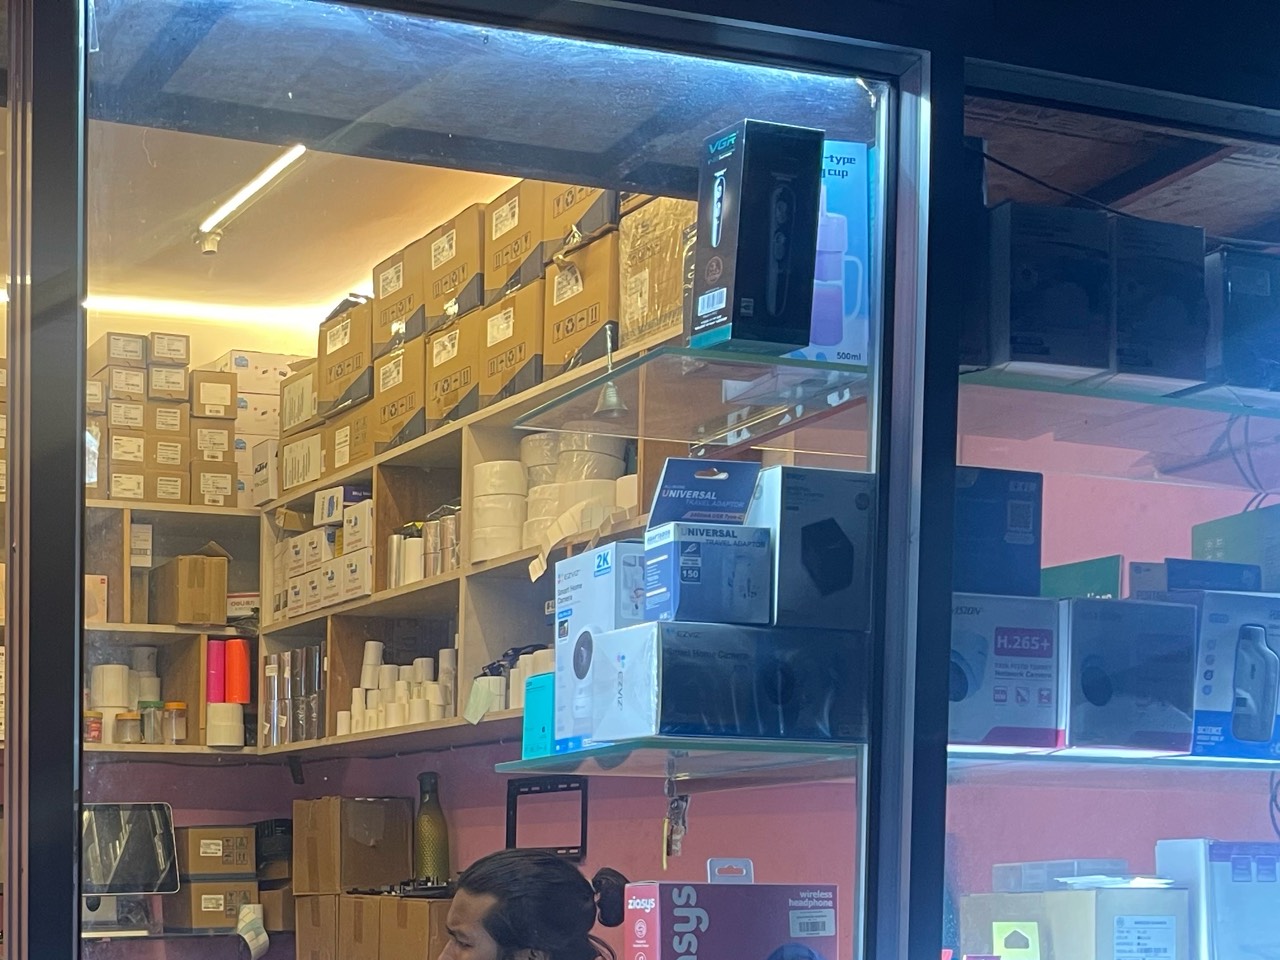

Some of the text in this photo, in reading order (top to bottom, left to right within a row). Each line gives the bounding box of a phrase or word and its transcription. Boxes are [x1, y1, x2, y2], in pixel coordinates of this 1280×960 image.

[708, 131, 738, 154] VGR
[827, 169, 849, 179] cup
[836, 351, 862, 362] 500ml
[662, 489, 717, 500] UNIVERSAL
[681, 527, 738, 539] UNIVERSAL
[596, 551, 610, 569] 2K
[682, 570, 699, 578] 150
[996, 636, 1051, 650] H.265+
[799, 890, 832, 899] wireless
[628, 896, 656, 913] ziasys
[788, 898, 832, 909] headphone
